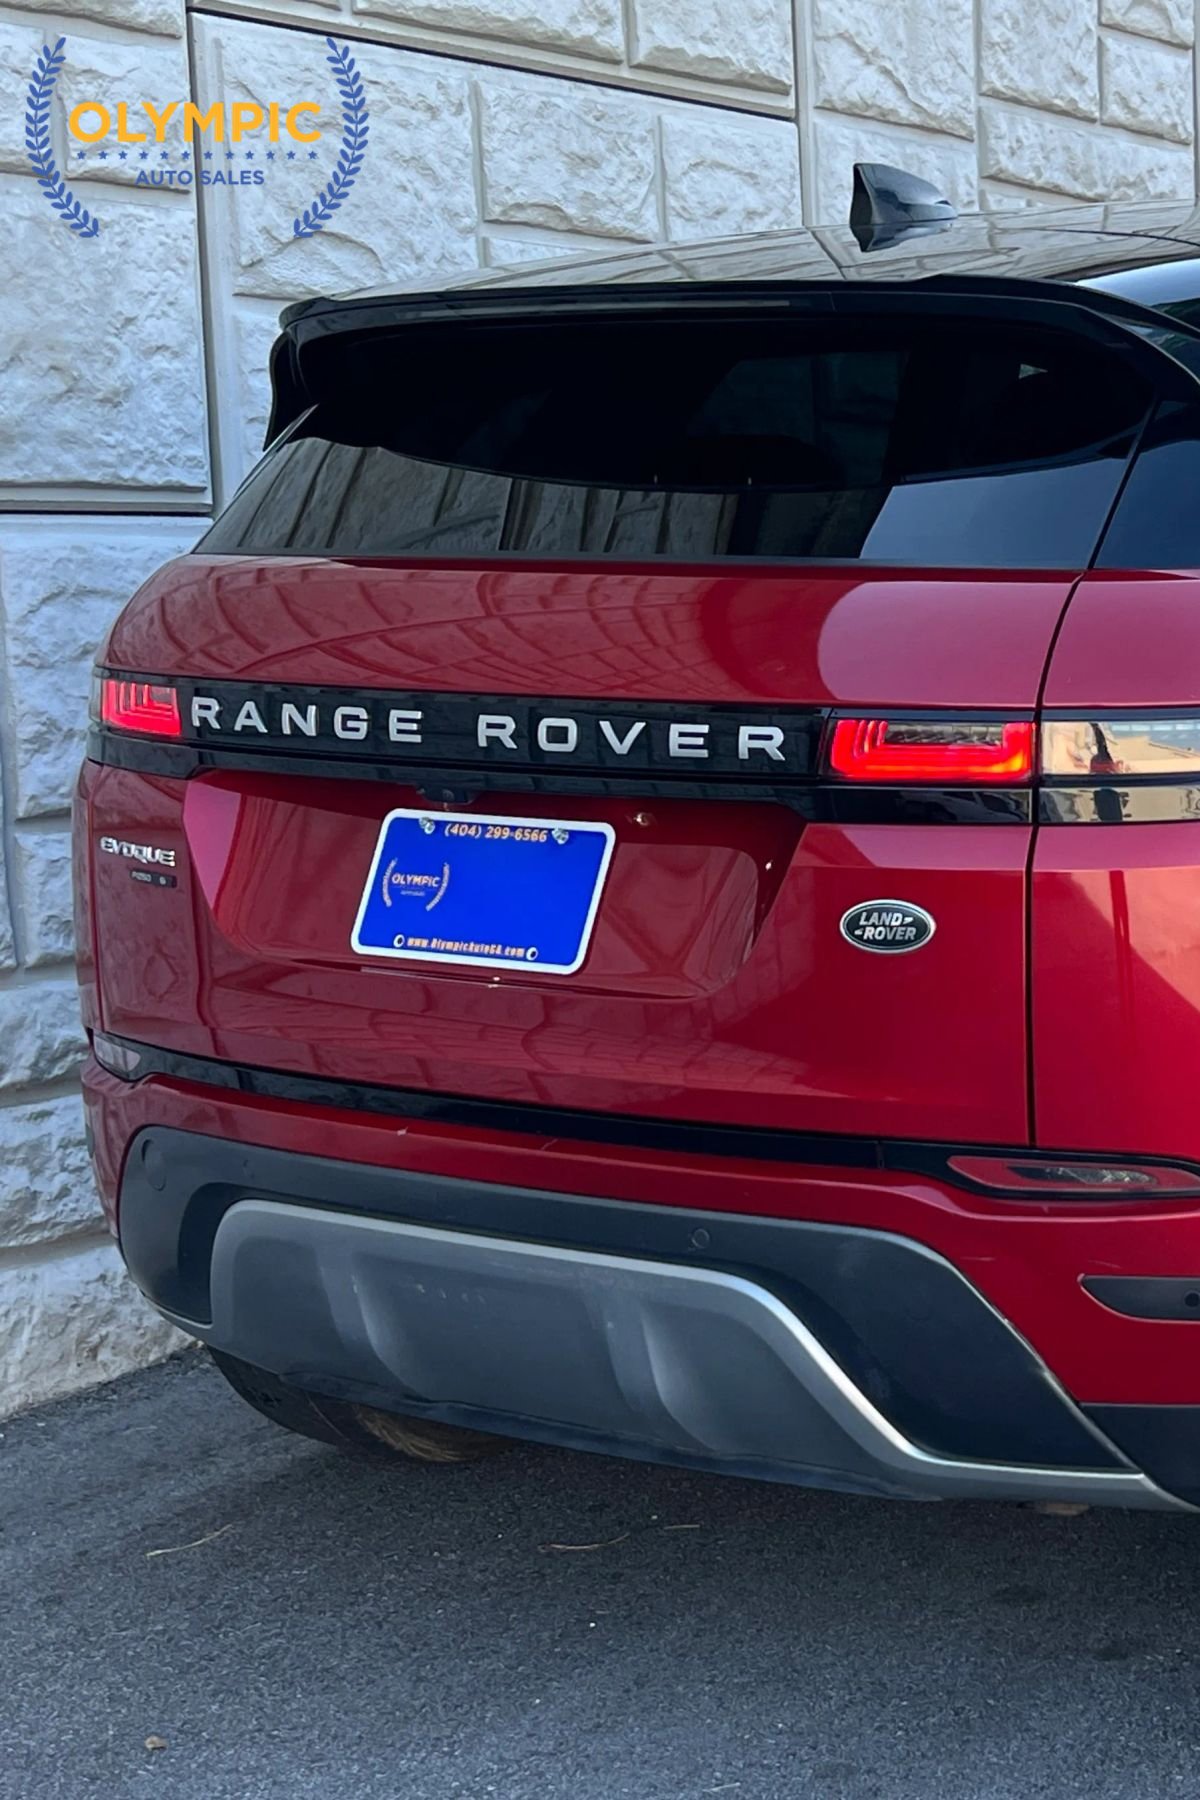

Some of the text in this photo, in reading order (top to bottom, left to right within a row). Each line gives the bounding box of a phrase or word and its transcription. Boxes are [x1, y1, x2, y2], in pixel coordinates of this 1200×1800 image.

[191, 696, 786, 761] RANGE ROVER
[445, 823, 548, 842] (404) 299-6566
[100, 836, 176, 867] EVOQUE
[391, 873, 441, 887] OLYMPIC
[859, 911, 903, 926] LAND
[863, 926, 917, 940] ROVER
